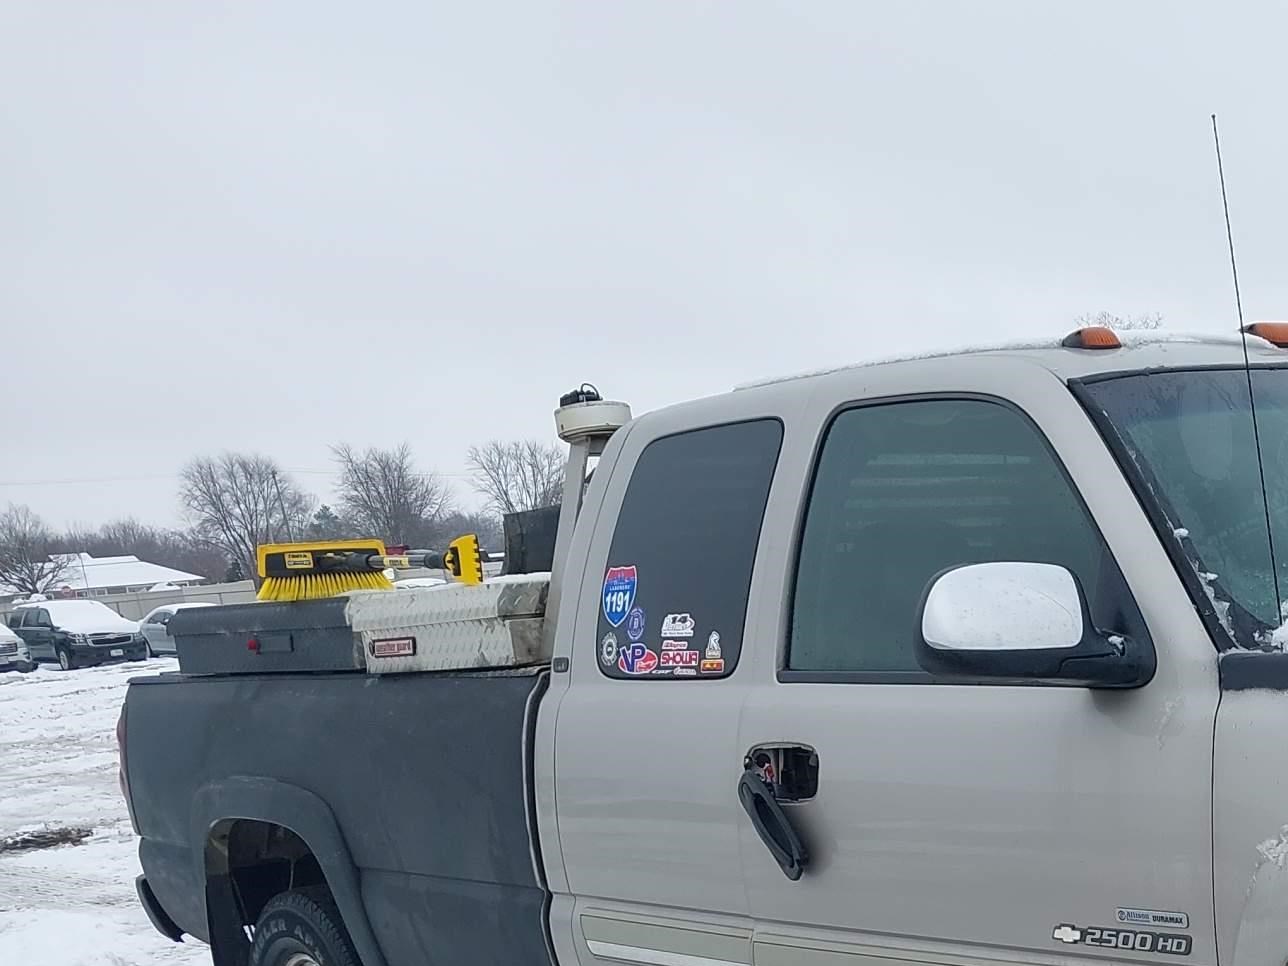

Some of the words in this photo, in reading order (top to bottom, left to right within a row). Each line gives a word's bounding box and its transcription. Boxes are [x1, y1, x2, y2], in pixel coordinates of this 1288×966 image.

[605, 591, 630, 613] 1191
[620, 643, 647, 673] VP
[661, 651, 698, 665] SHOWA
[1152, 915, 1183, 924] DURAMAX
[1085, 928, 1152, 951] 2500
[1157, 937, 1187, 952] HD
